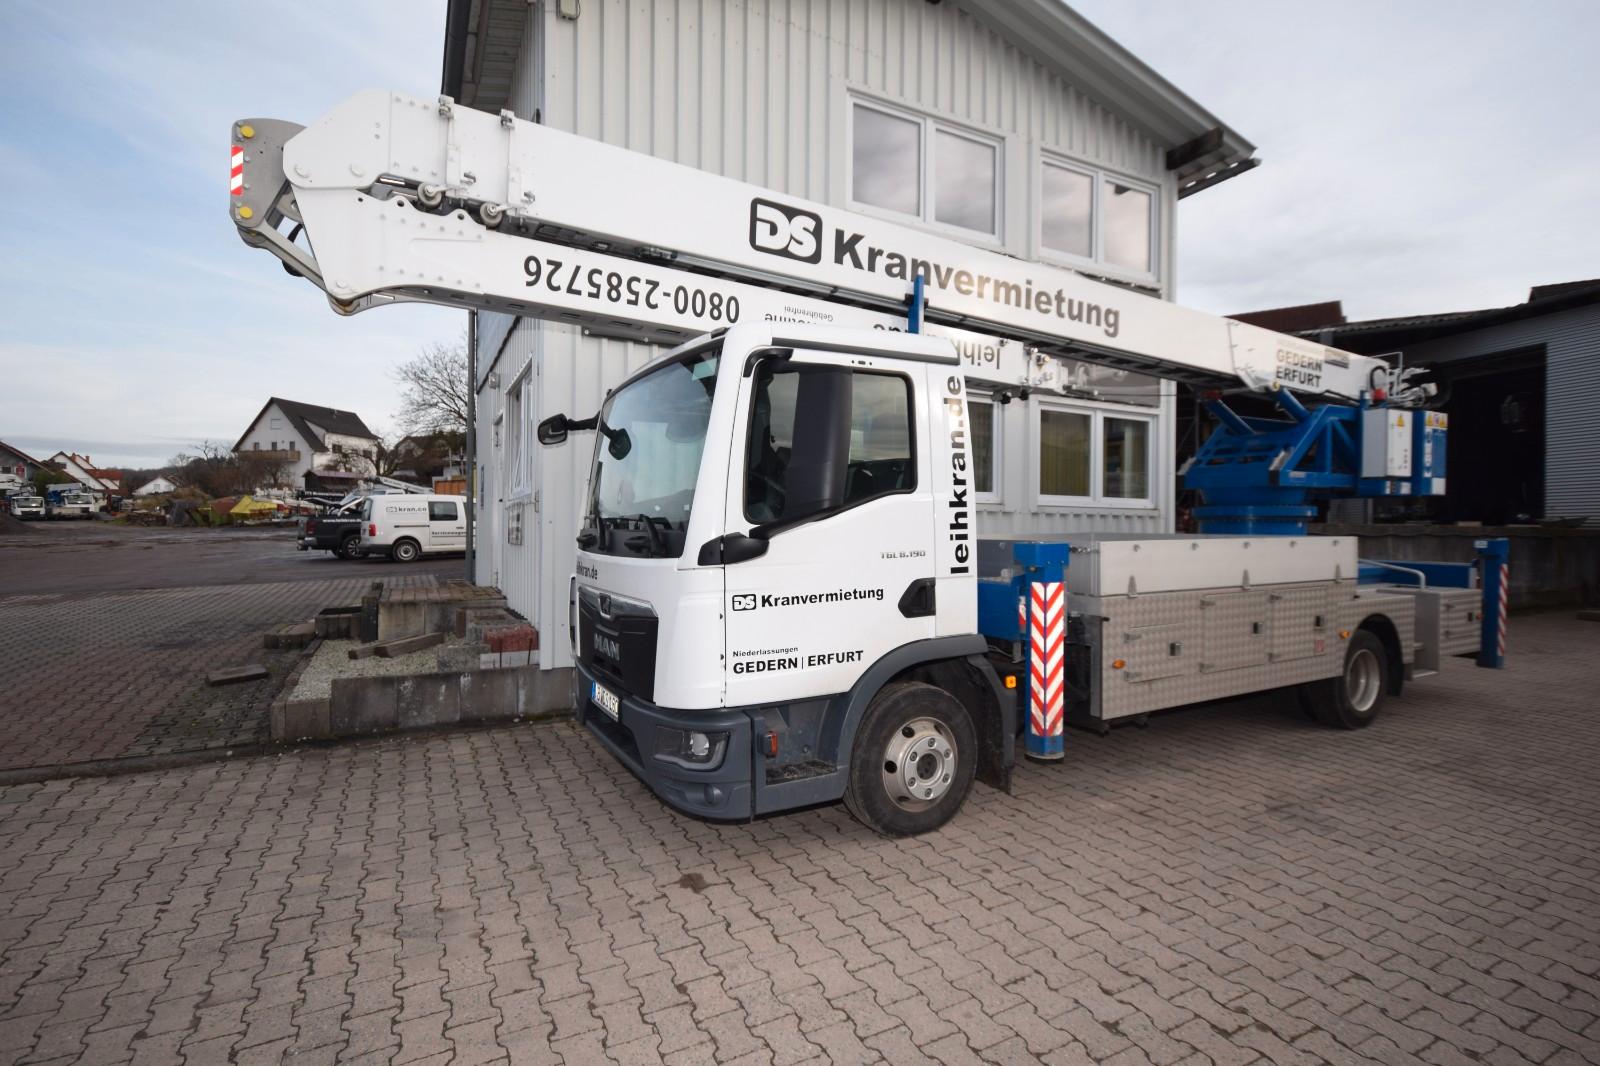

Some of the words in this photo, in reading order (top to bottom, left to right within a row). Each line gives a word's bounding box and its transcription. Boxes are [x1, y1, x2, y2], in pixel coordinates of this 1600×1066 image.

[751, 198, 821, 262] DS
[834, 228, 1121, 337] Kranvermietung
[523, 255, 739, 324] 0800-2585726
[1276, 349, 1322, 371] GEDERN
[1276, 366, 1322, 387] ERFURT
[943, 375, 969, 574] leihkran.de
[761, 588, 884, 608] Kranvermietung
[594, 633, 620, 660] MAN
[732, 647, 799, 657] Niederlassungen
[733, 657, 798, 674] GEDERN
[807, 650, 864, 667] ERFURT
